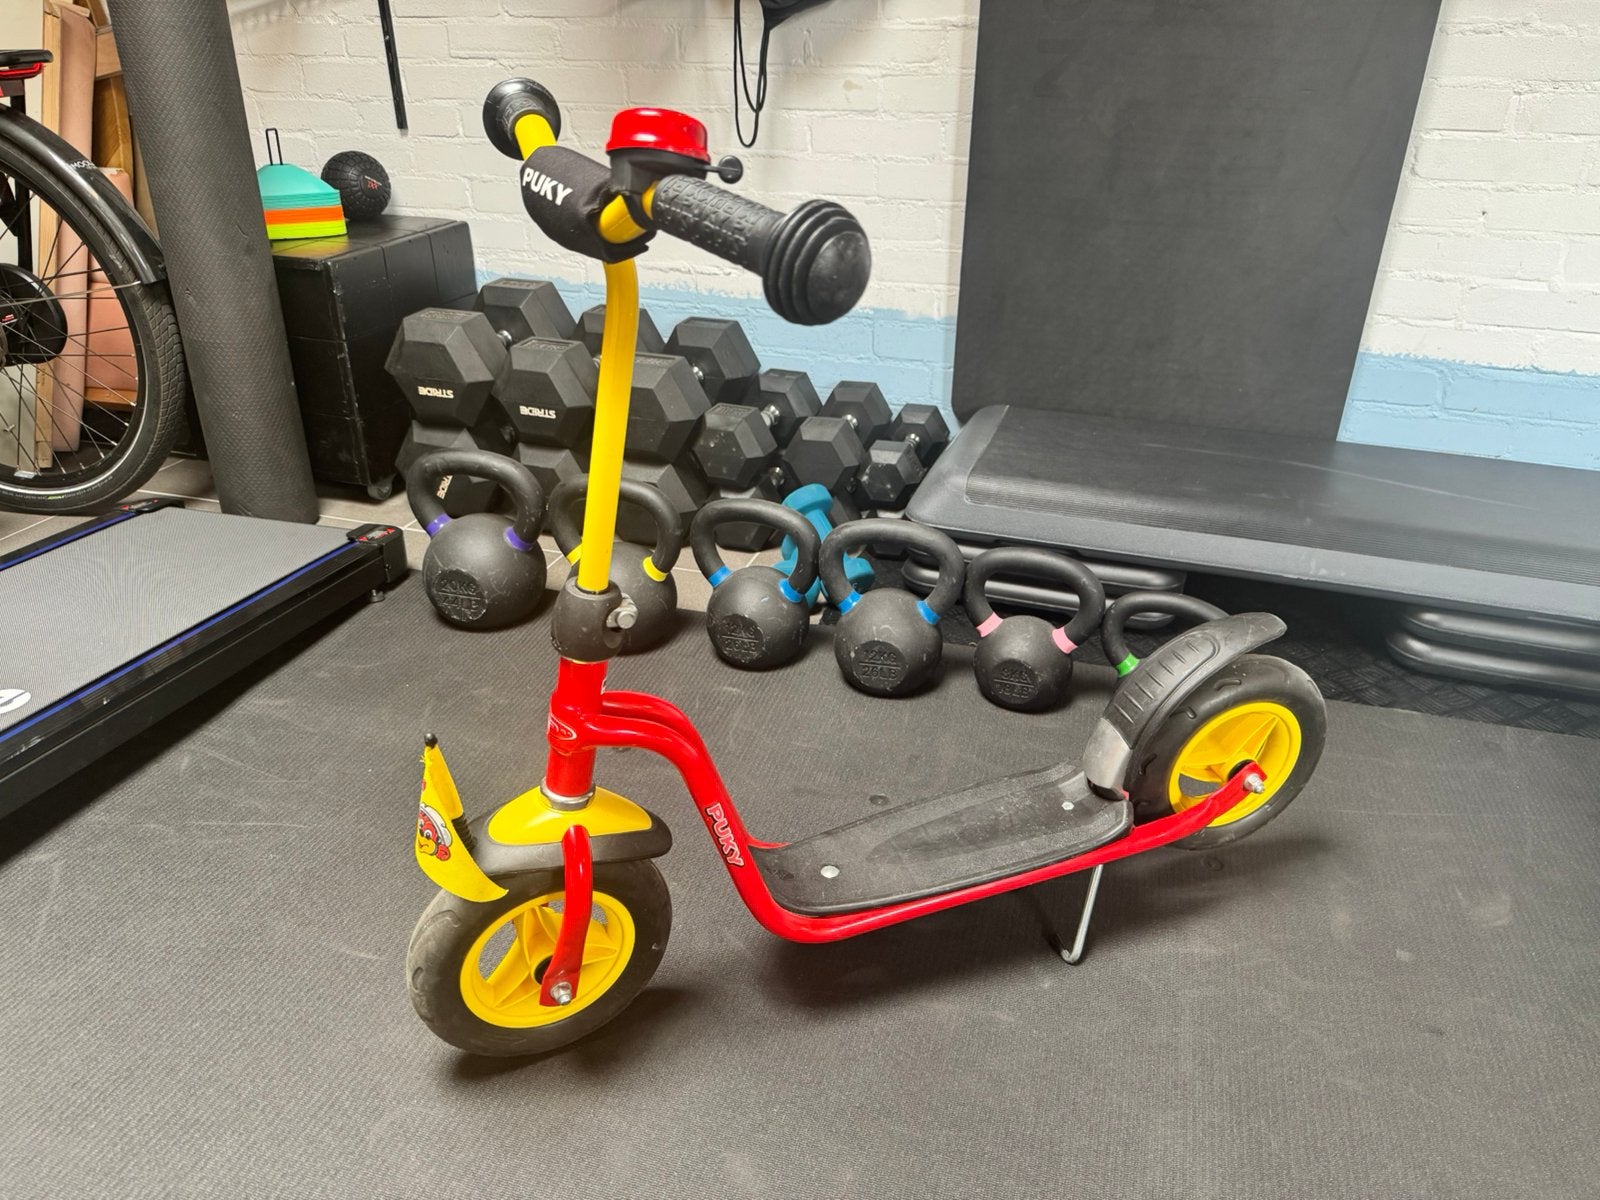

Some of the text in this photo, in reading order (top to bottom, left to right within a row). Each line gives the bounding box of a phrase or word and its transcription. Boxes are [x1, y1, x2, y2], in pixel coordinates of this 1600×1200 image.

[522, 167, 573, 206] PUKY
[418, 386, 454, 399] STRIDE
[519, 405, 556, 419] STRIDE
[436, 475, 453, 500] TRIDE
[438, 578, 477, 595] 20KG
[862, 649, 897, 665] 12KG
[862, 665, 897, 680] 26LB
[705, 802, 745, 867] PUKY
